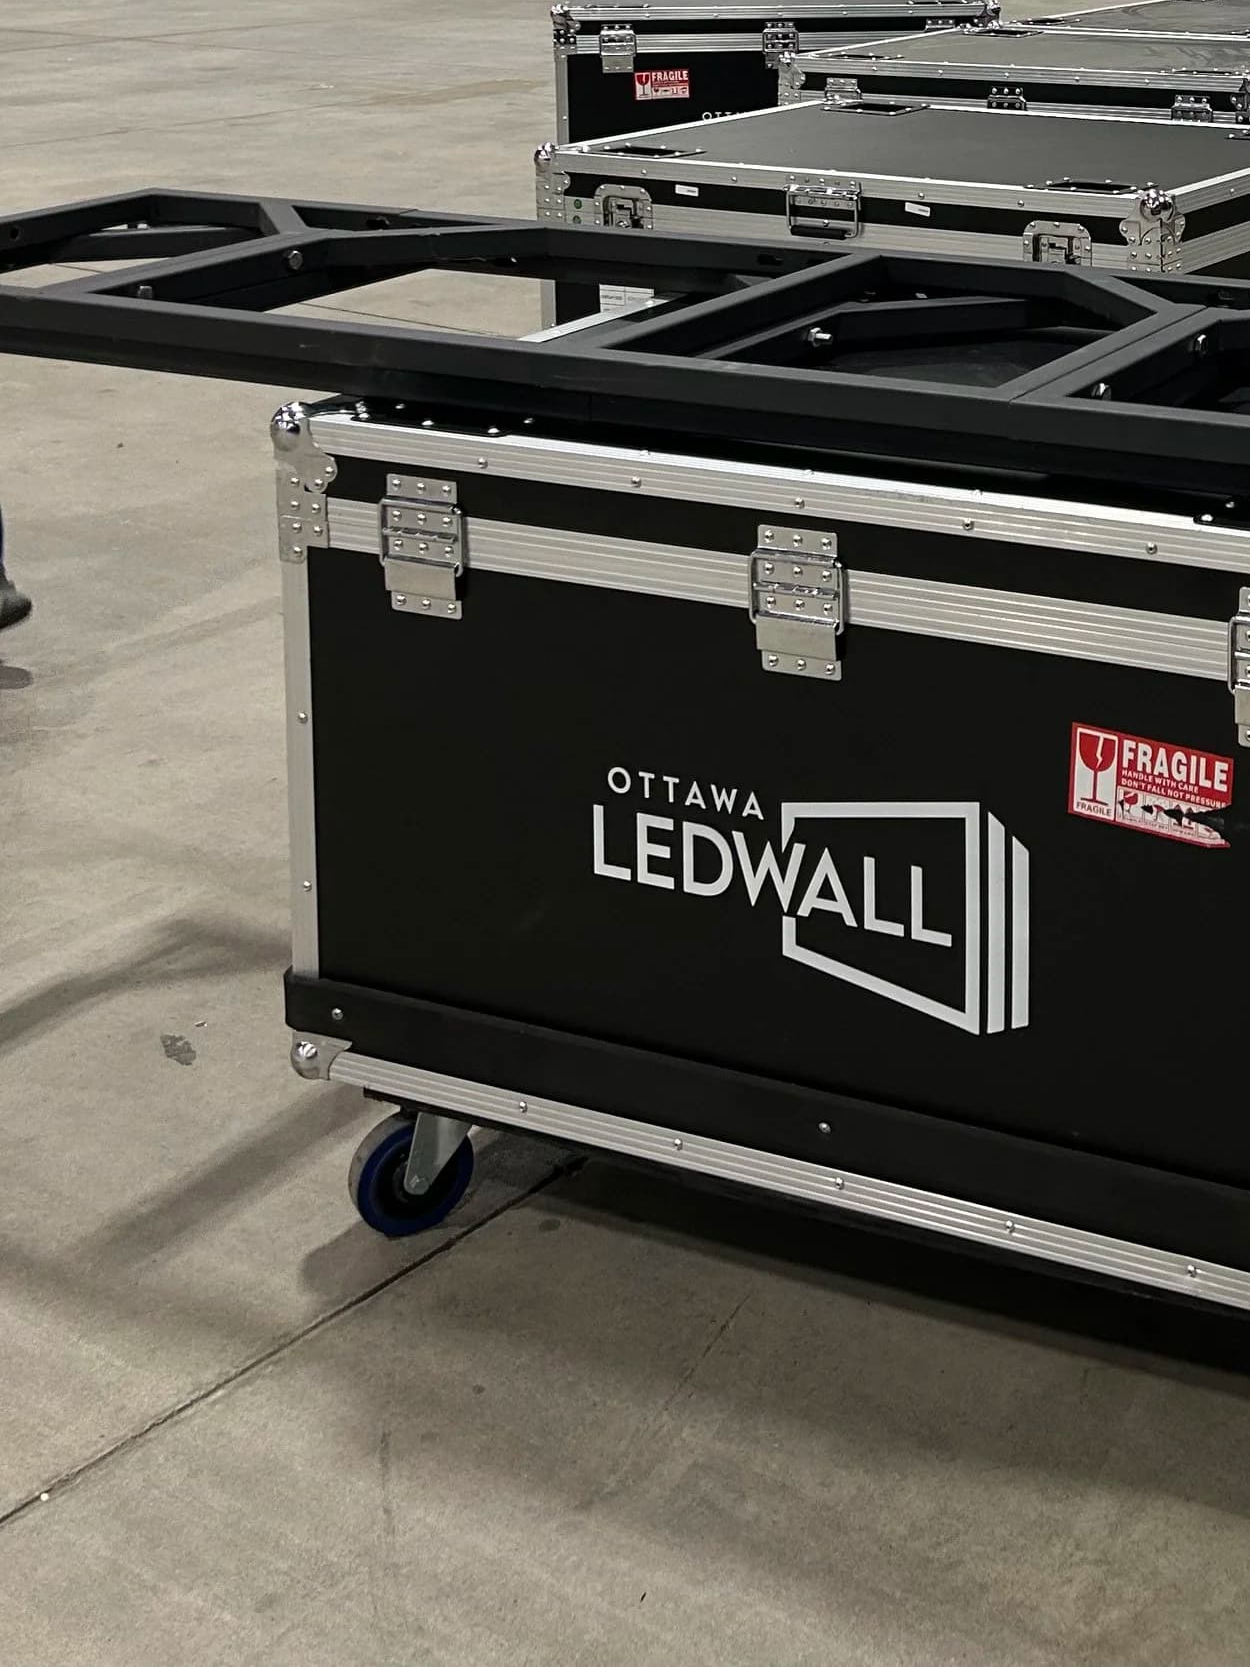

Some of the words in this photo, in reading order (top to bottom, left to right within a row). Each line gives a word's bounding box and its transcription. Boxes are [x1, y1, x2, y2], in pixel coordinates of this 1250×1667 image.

[652, 70, 689, 82] FRAGILE
[1122, 739, 1229, 793] FRAGILE
[607, 766, 764, 821] OTTAWA
[1121, 769, 1153, 783] HANDLE
[1155, 777, 1177, 789] WITH
[1178, 781, 1199, 794] CARE
[1121, 778, 1146, 791] DON'T
[1147, 784, 1166, 796] FALL
[1167, 788, 1183, 799] NOT
[1075, 801, 1112, 817] FRAGILE
[593, 804, 953, 948] LEDWALL
